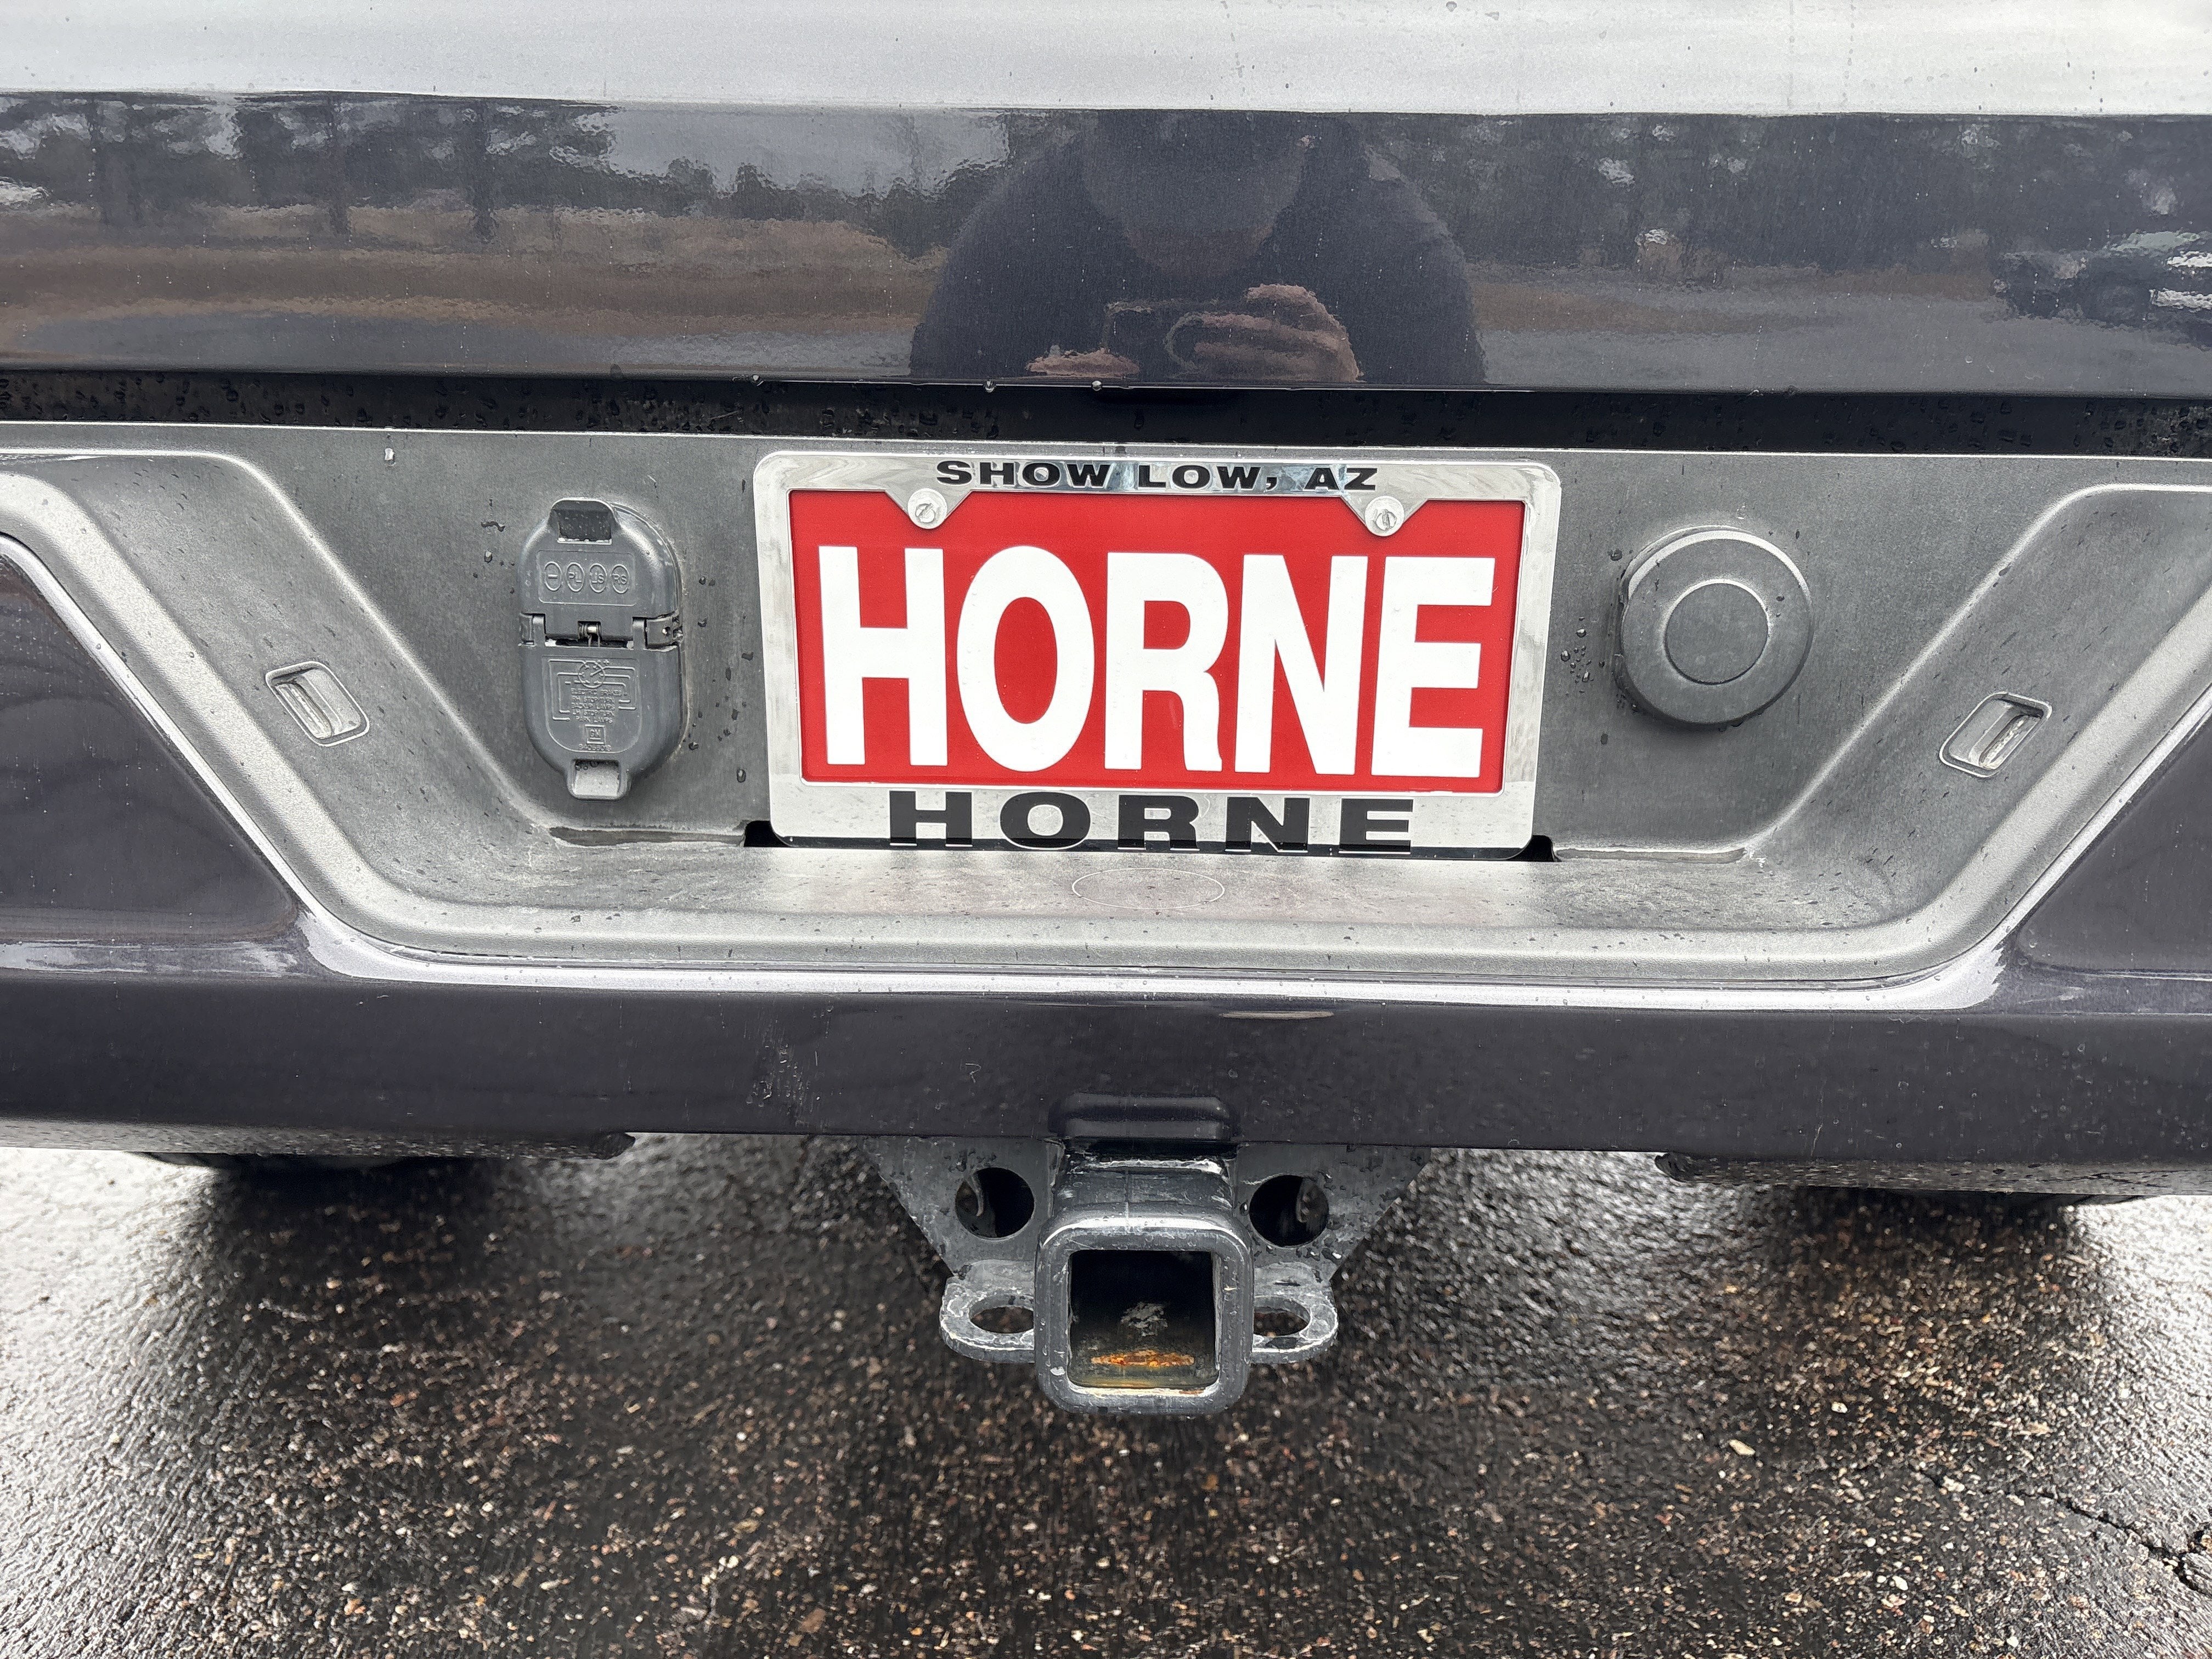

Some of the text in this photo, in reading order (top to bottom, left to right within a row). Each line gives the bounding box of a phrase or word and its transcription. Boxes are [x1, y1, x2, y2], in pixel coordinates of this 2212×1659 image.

[936, 460, 1378, 492] SHOW LOW, AZ
[818, 545, 1496, 778] HORNE
[889, 790, 1415, 854] HORNE
